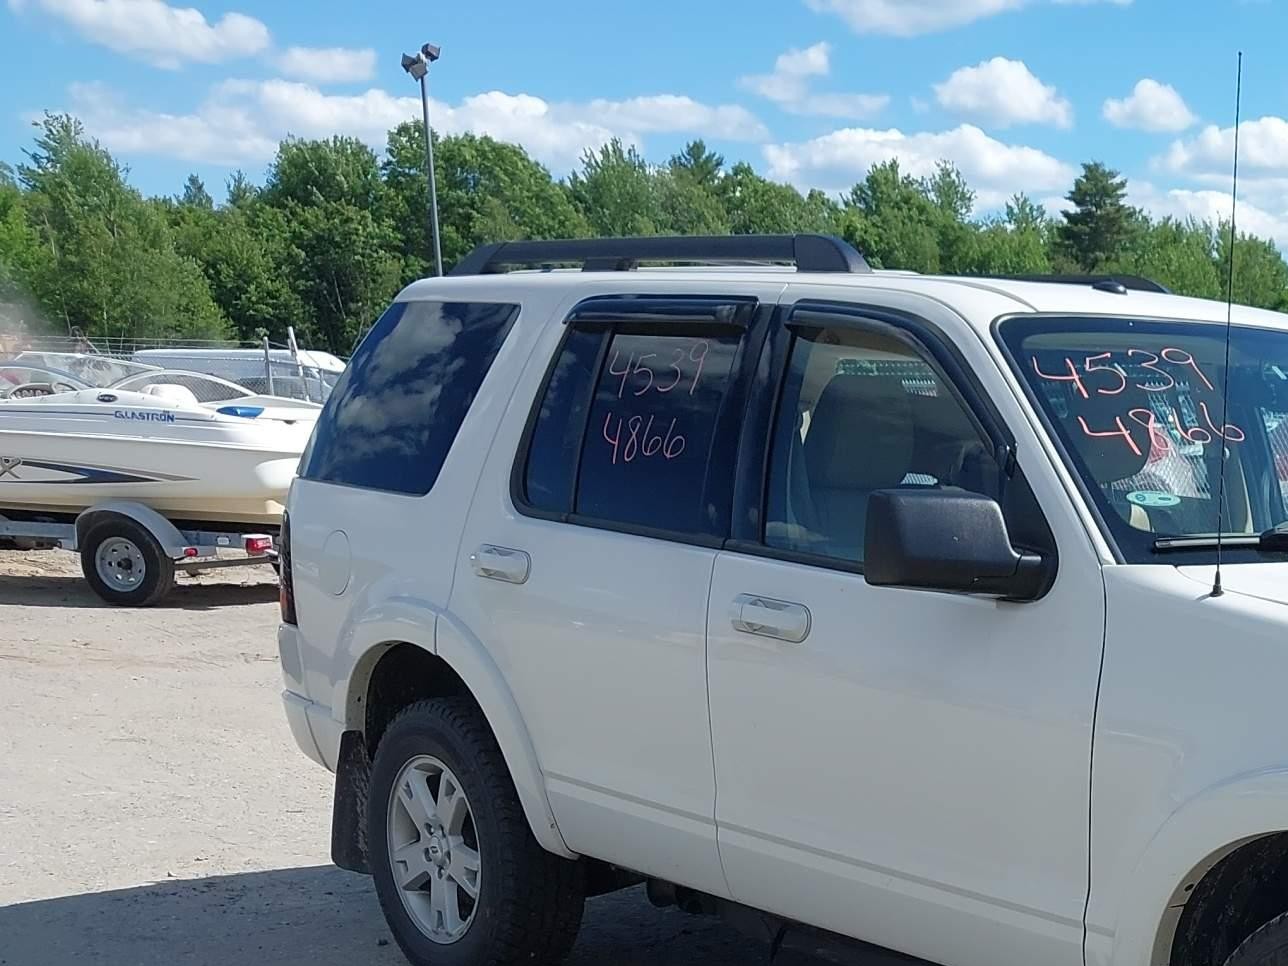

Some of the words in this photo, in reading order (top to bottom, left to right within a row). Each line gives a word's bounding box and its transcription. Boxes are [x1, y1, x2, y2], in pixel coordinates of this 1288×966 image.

[609, 340, 709, 399] 4539
[1032, 347, 1214, 399] 4539
[113, 409, 176, 423] GLASTRON
[603, 411, 686, 465] 4866
[1077, 401, 1245, 456] 4866
